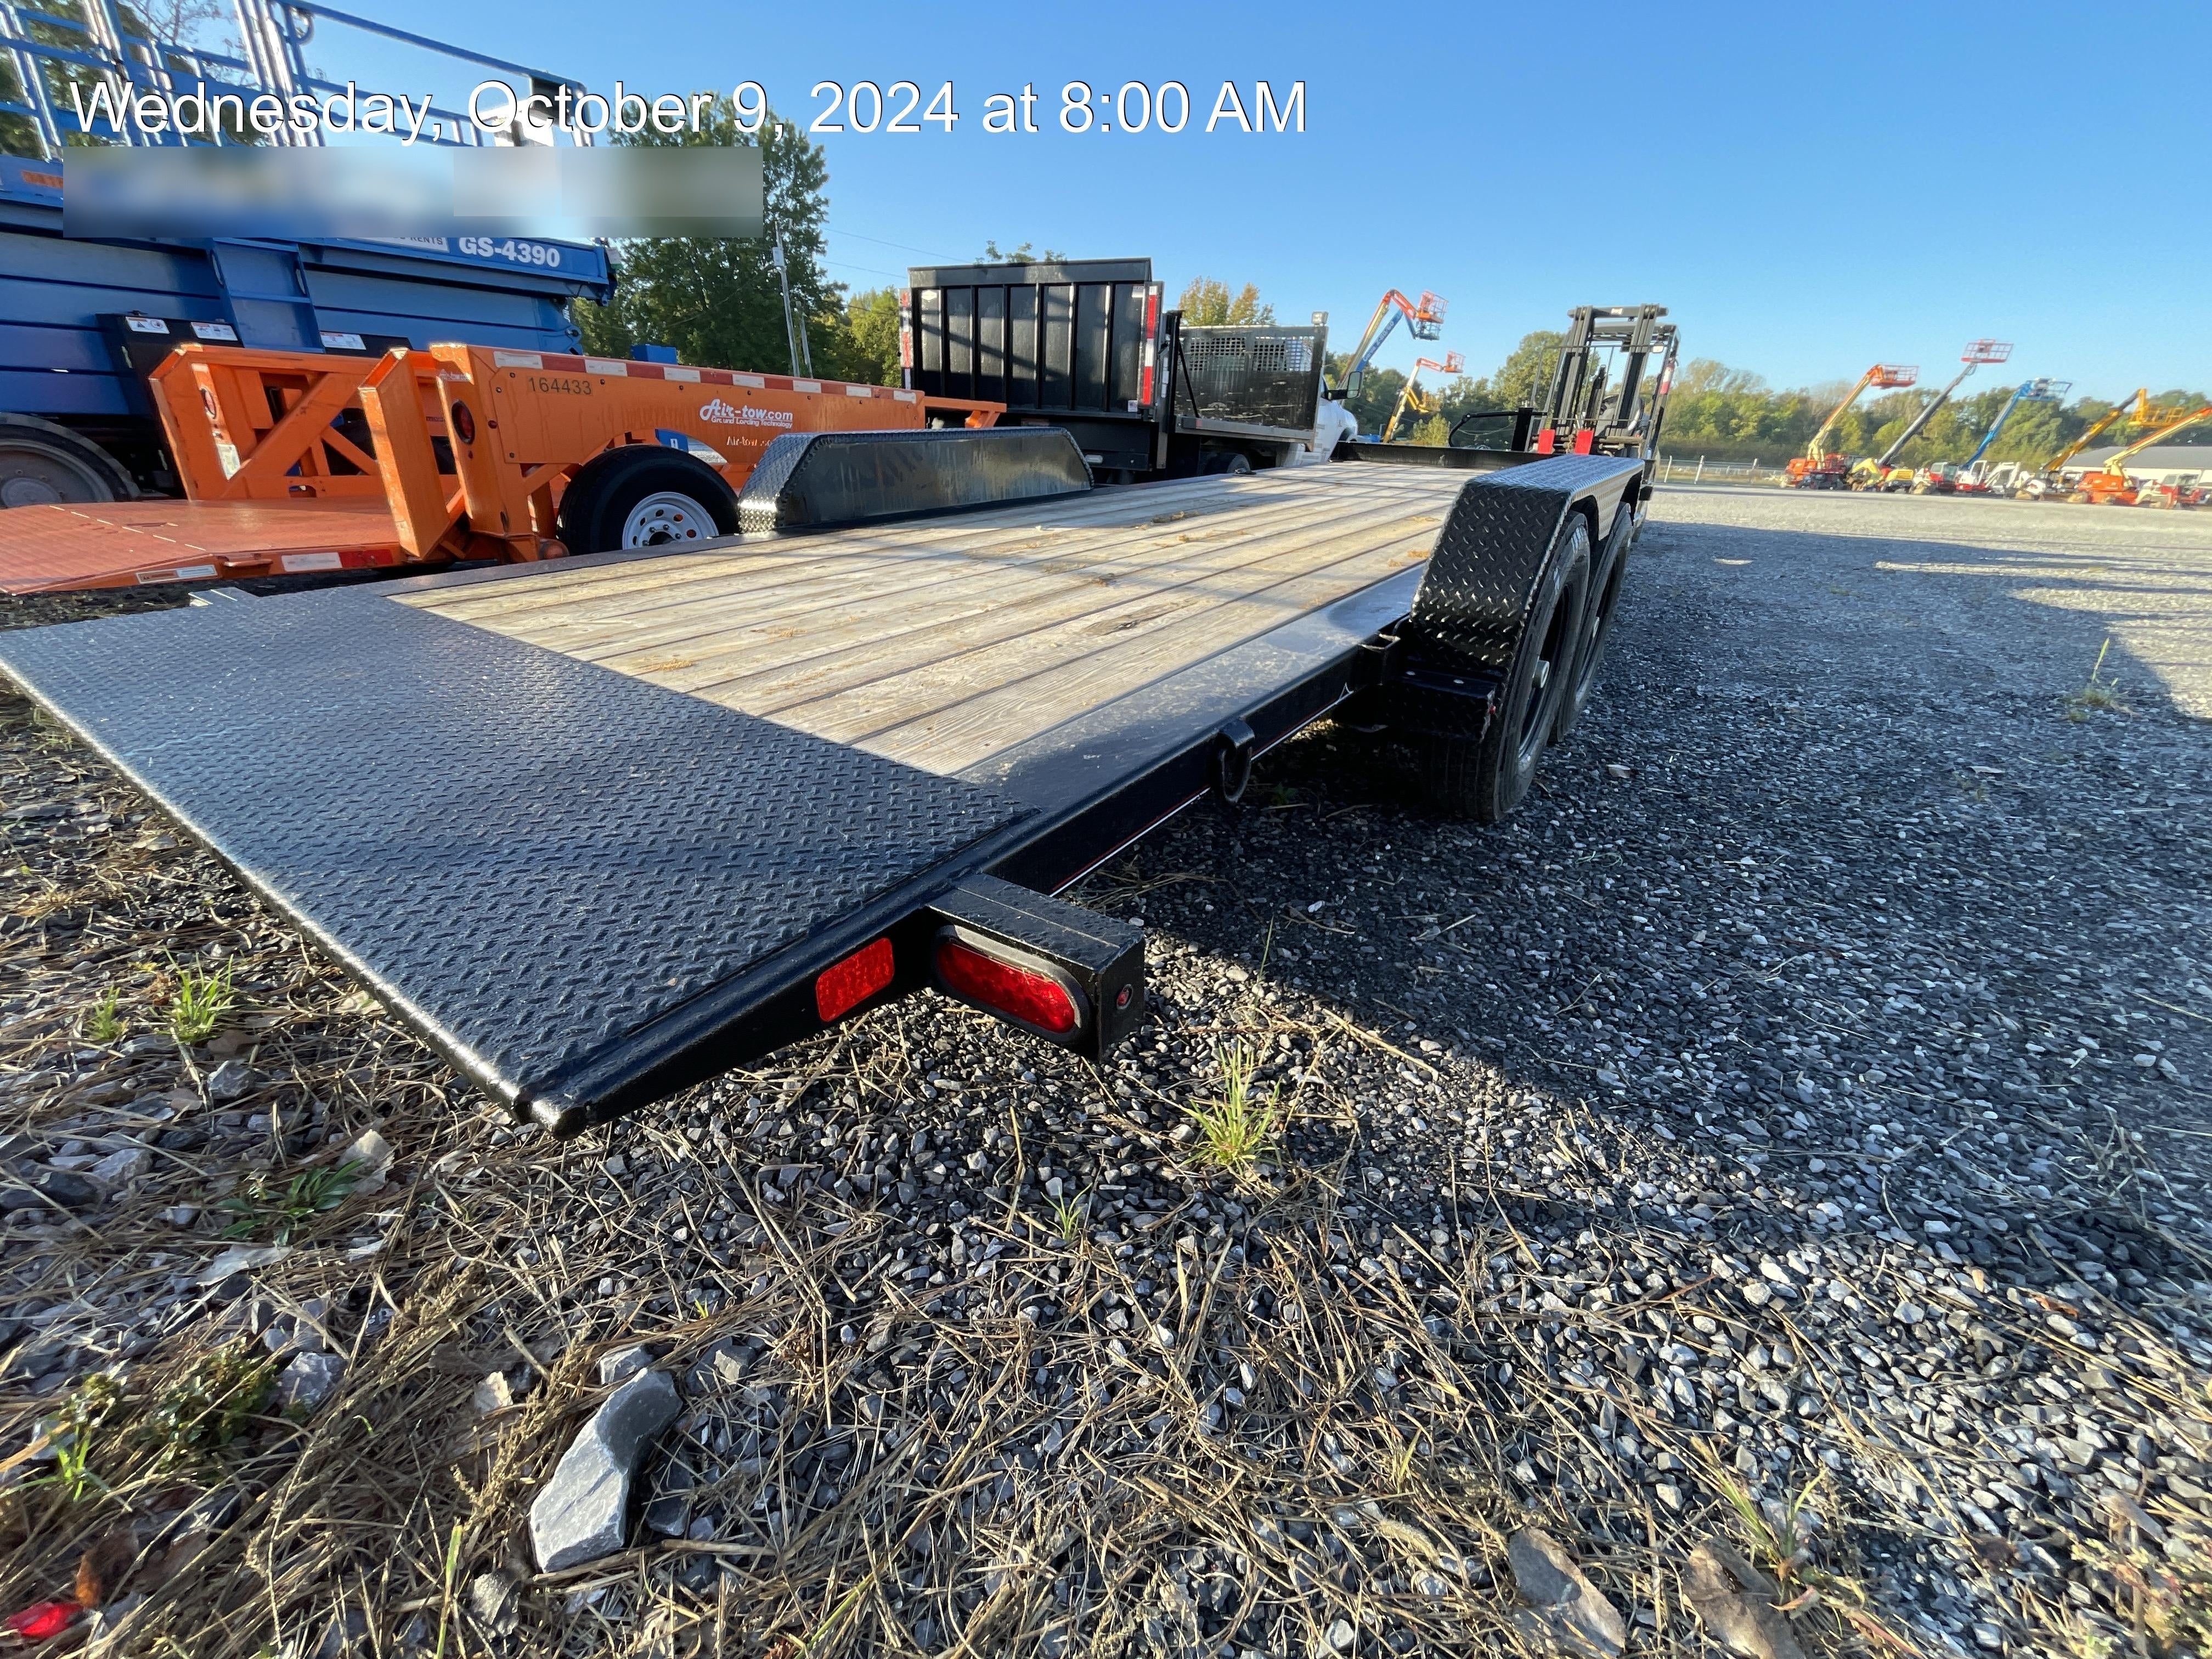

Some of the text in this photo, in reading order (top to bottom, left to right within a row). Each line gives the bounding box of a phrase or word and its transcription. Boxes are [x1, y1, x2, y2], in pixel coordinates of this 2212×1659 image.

[459, 238, 560, 267] GS-4390
[529, 377, 591, 394] 164433
[699, 399, 793, 420] Air-tow.com
[761, 419, 793, 428] Technology
